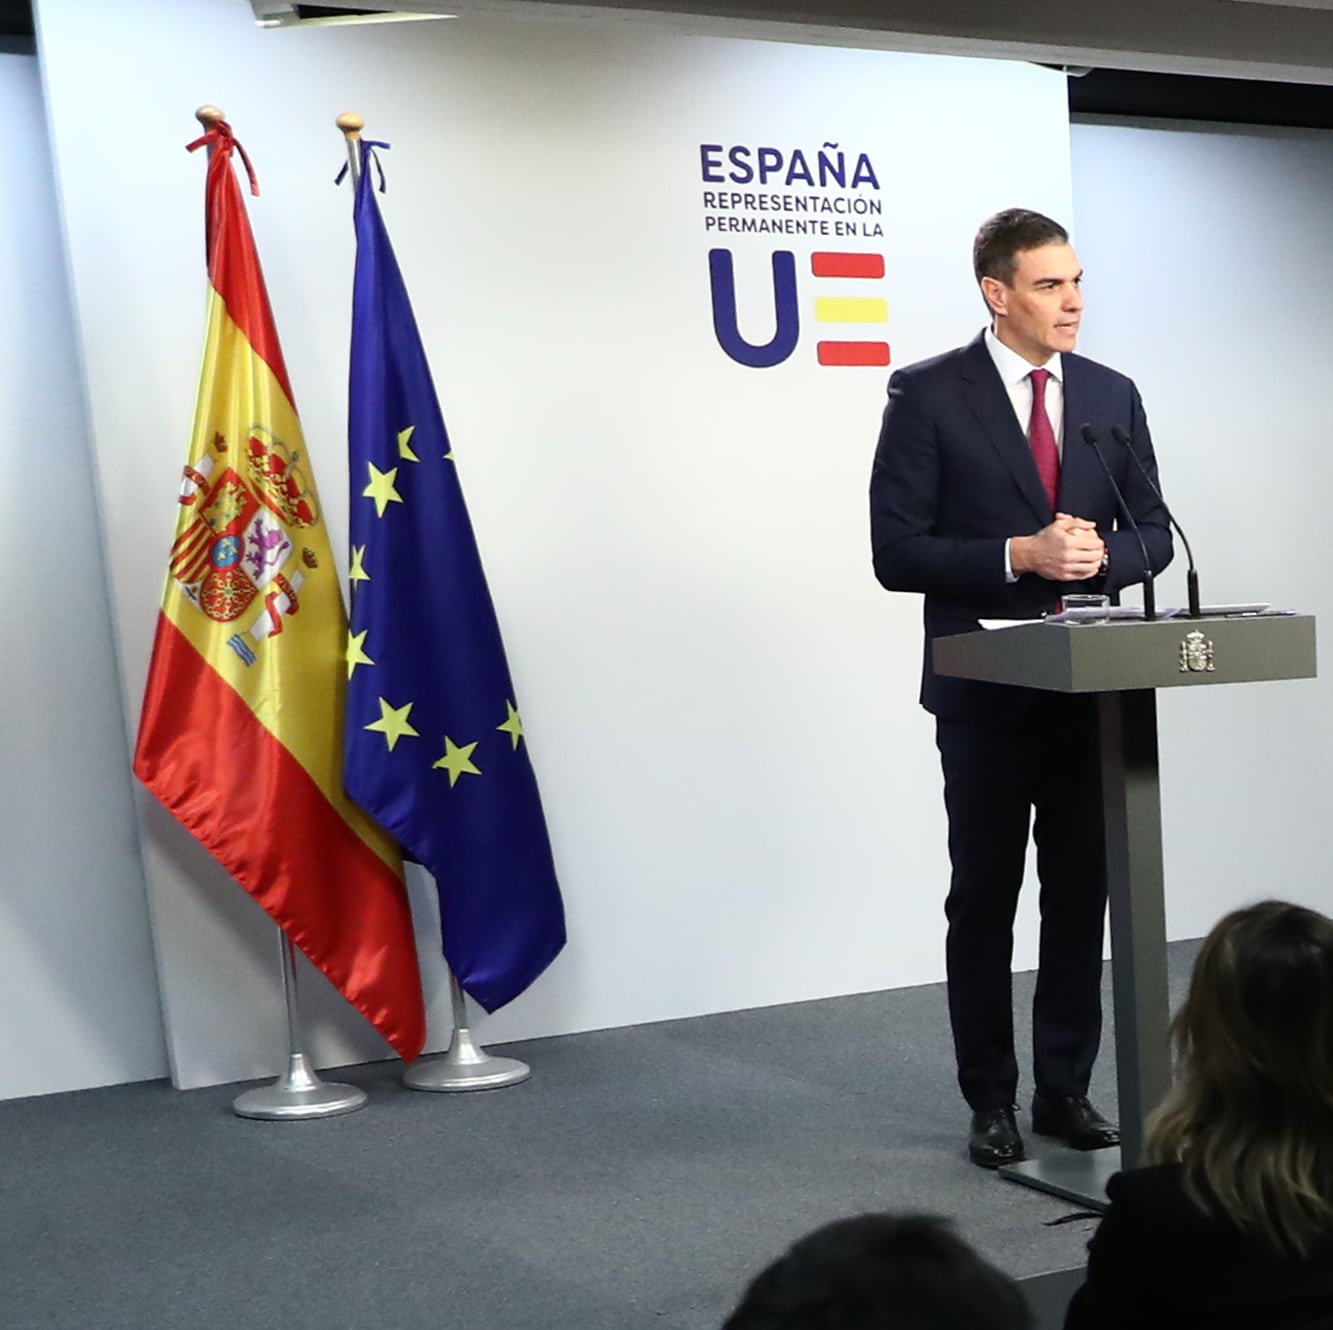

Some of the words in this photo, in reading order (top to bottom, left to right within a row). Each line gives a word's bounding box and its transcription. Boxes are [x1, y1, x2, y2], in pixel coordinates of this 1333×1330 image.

[700, 142, 880, 190] ESPAÑA
[703, 192, 882, 215] REPRESENTACIÓN
[705, 216, 829, 236] PERMANENTE
[835, 220, 857, 237] EN
[862, 222, 884, 238] LA
[708, 248, 891, 368] UE
